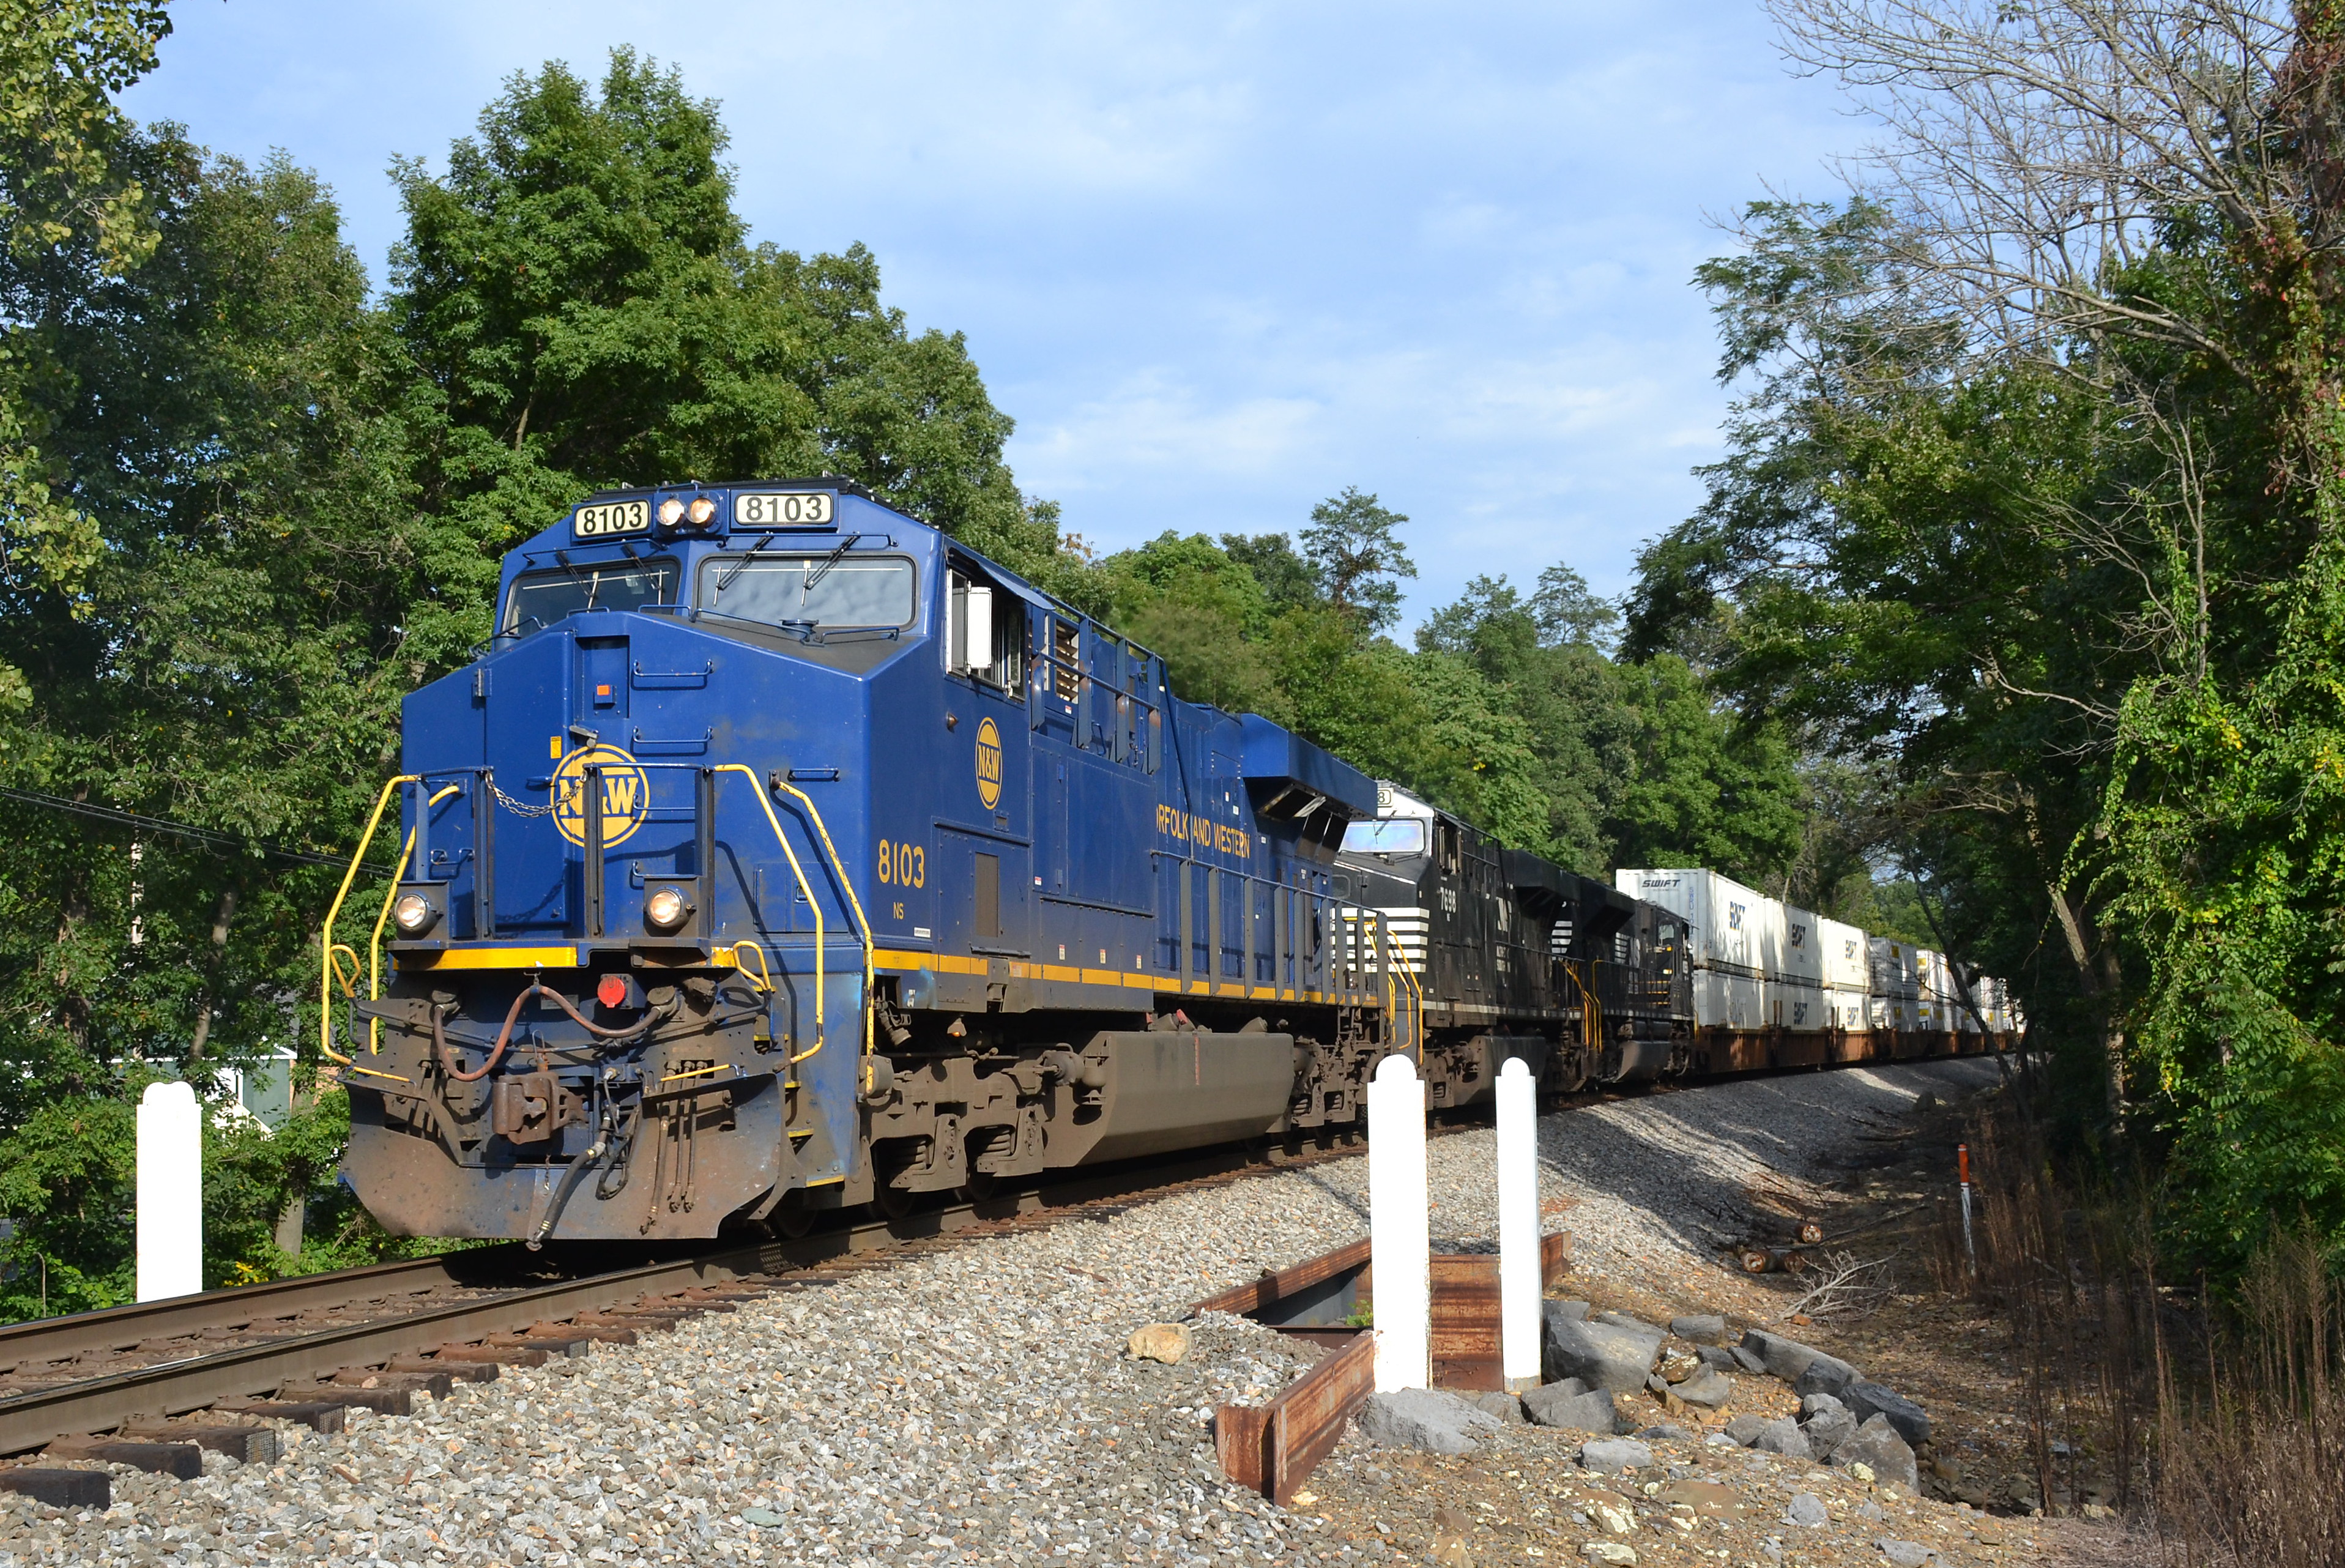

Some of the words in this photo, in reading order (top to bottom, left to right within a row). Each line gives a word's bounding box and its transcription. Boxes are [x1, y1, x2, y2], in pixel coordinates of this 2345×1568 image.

[583, 503, 642, 533] 8103
[746, 495, 822, 522] 8103
[978, 745, 1000, 785] N&W
[1156, 803, 1189, 841] RFOLK
[1194, 815, 1211, 847] AND
[1213, 822, 1249, 859] WESTERN
[878, 839, 924, 889] 8103
[1642, 879, 1681, 888] SWIFT
[893, 901, 904, 920] NS
[1440, 886, 1457, 913] 7698
